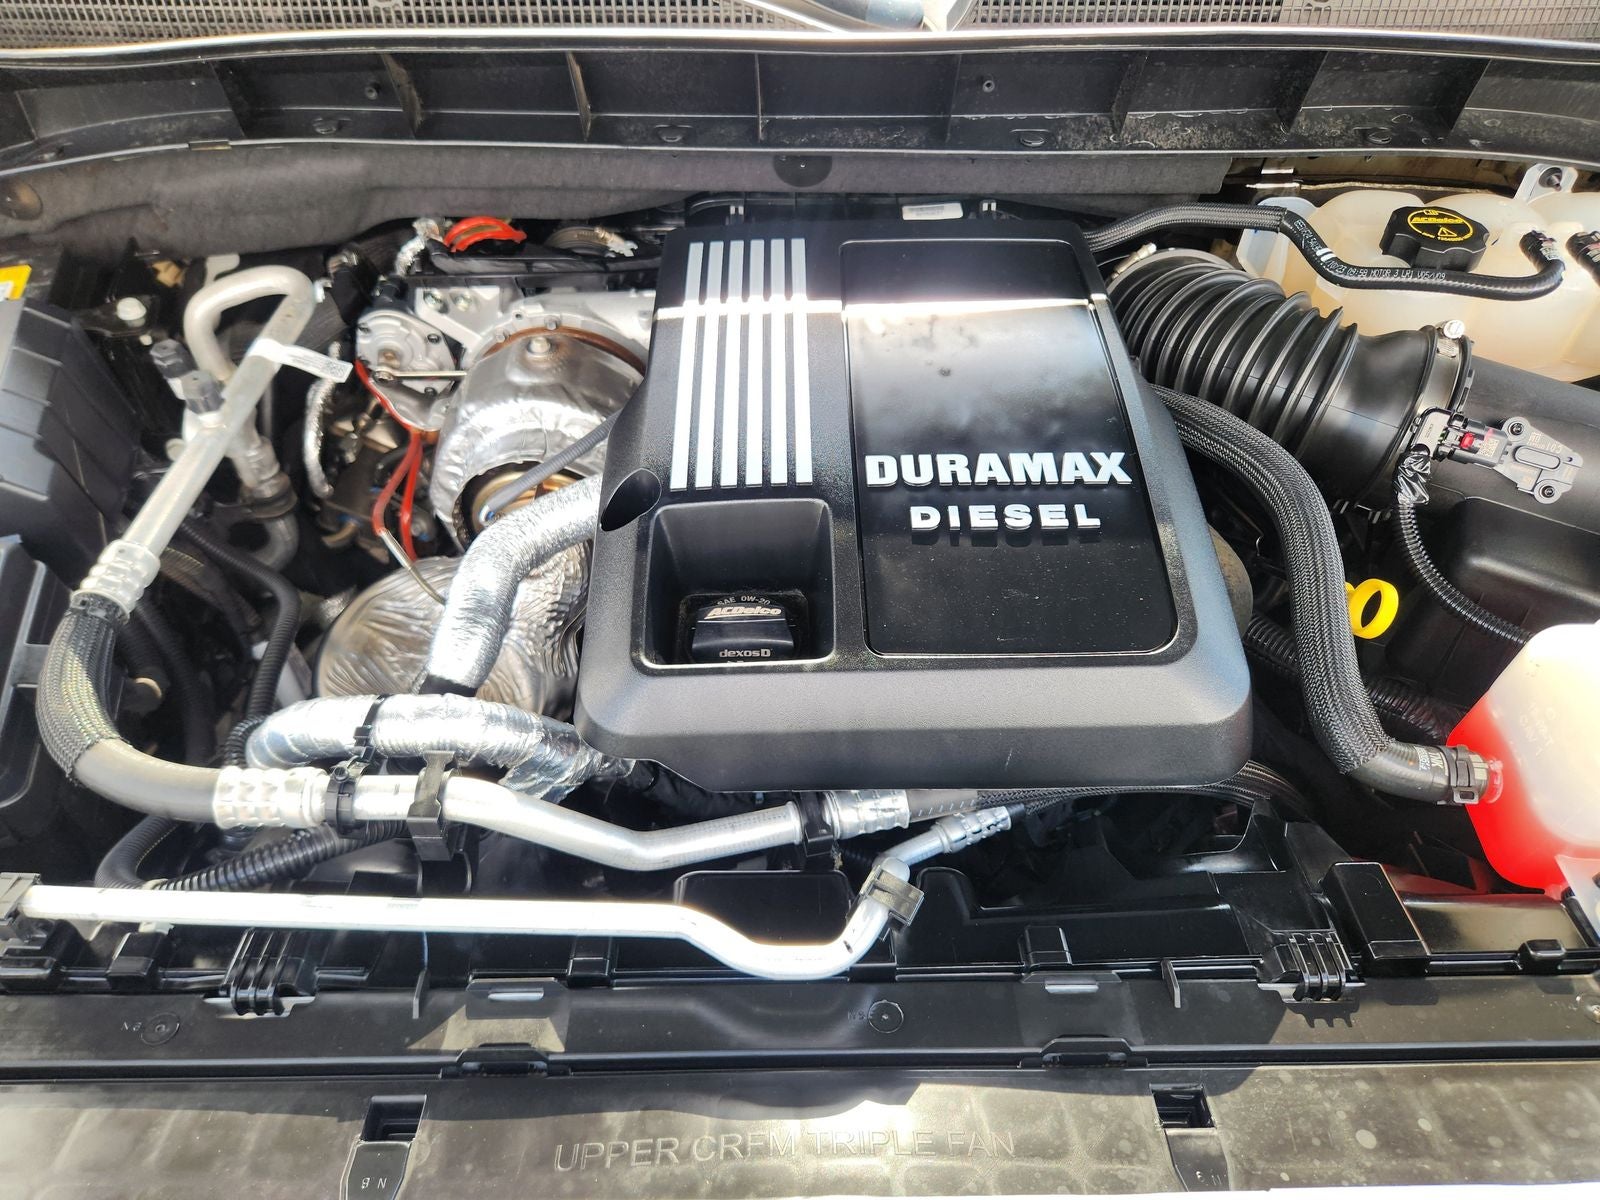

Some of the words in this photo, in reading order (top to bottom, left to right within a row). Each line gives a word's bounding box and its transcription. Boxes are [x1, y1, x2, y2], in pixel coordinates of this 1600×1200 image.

[865, 452, 1132, 487] DURAMAX
[910, 503, 1101, 531] DIESEL
[704, 606, 782, 619] ACDelco
[554, 1137, 681, 1172] UPPER
[807, 1129, 937, 1157] TRIPLE
[947, 1131, 1018, 1159] FAN
